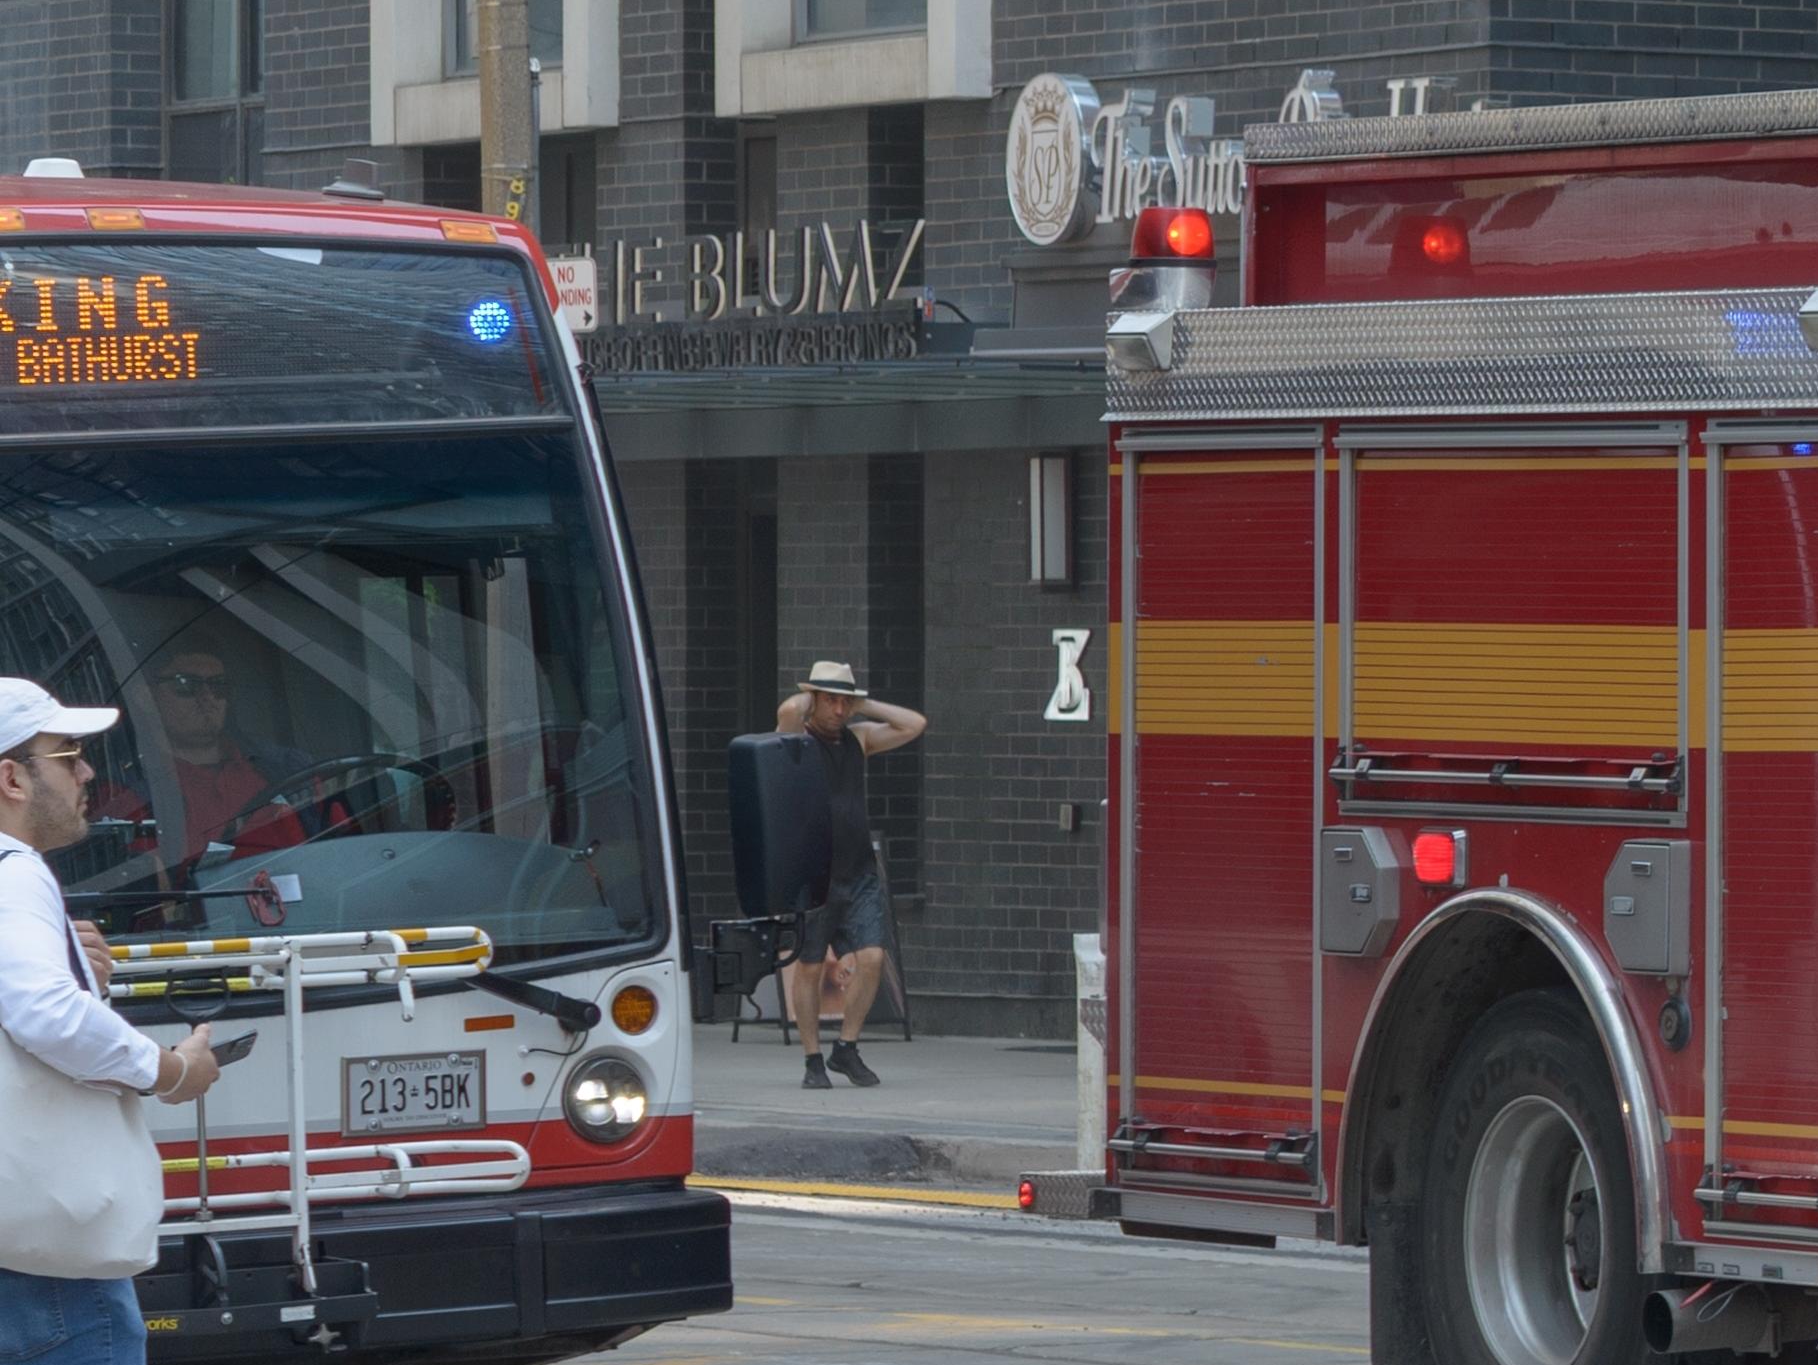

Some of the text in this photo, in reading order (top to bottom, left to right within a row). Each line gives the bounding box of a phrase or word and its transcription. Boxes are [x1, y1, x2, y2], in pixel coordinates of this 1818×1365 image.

[1090, 88, 1154, 224] The
[1156, 96, 1246, 217] Sutto
[557, 266, 575, 283] NO
[684, 217, 926, 323] BLUMZ
[559, 288, 592, 306] NDING
[17, 333, 199, 385] BATHURST
